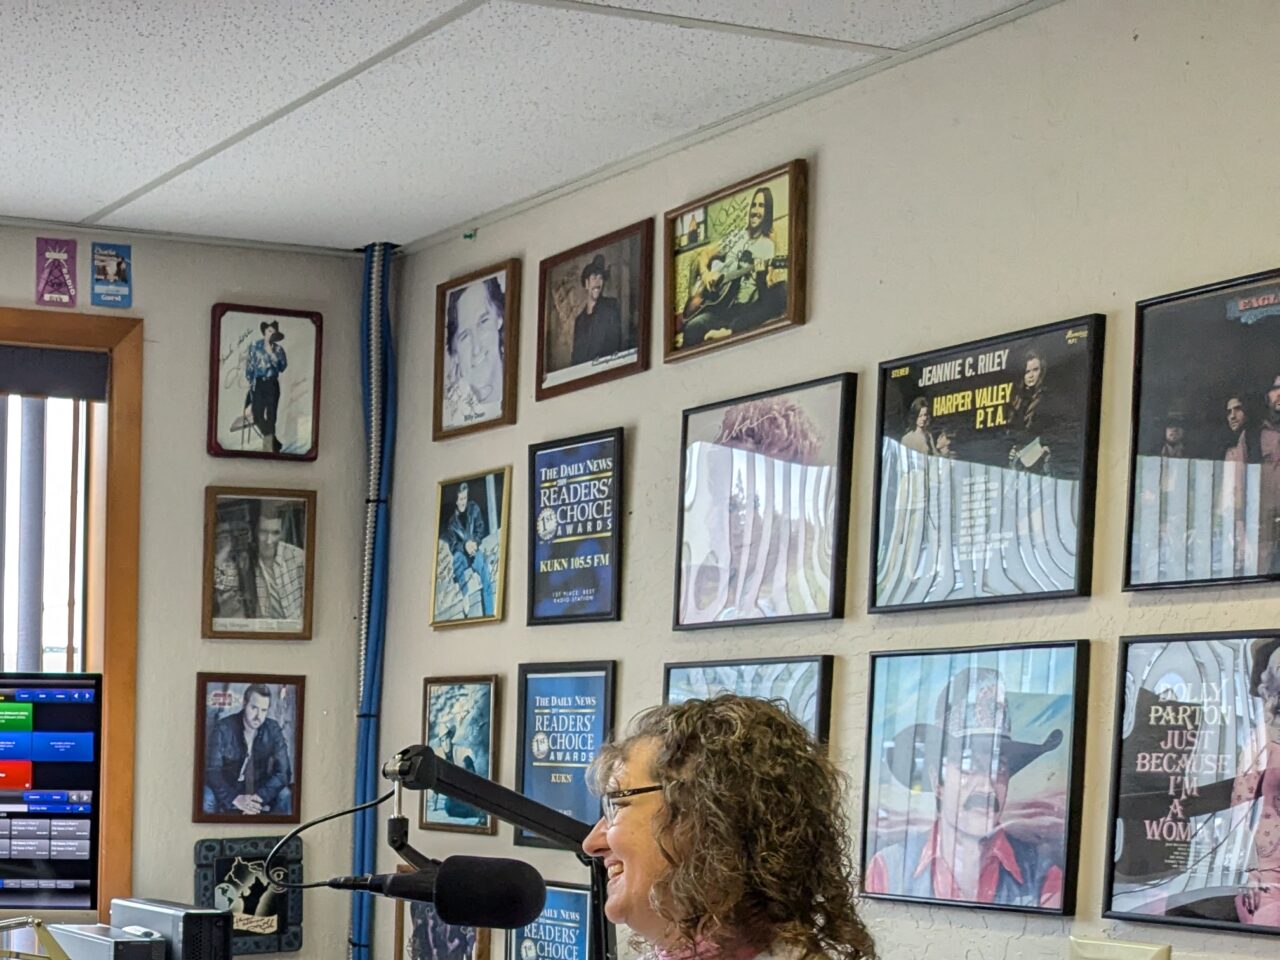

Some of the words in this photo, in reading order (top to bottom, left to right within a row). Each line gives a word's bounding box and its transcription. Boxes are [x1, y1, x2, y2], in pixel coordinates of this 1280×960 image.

[891, 367, 909, 378] STEREO
[918, 359, 962, 387] JEANNIE
[965, 357, 975, 376] C.
[933, 390, 971, 417] HARPER
[975, 382, 1013, 407] VALLEY
[540, 466, 558, 481] THE
[560, 462, 586, 478] DAILY
[586, 457, 613, 473] NEWS
[539, 478, 613, 508] READERS'
[556, 499, 612, 524] CHOICE
[556, 518, 612, 536] AWARDS
[539, 558, 568, 573] KUKN
[570, 555, 592, 570] 105.5
[594, 553, 609, 567] FM
[1158, 679, 1229, 702] DOLLY
[535, 696, 550, 707] THE
[551, 696, 572, 707] DAILY
[574, 696, 596, 706] NEWS
[535, 715, 595, 731] READERS'
[1149, 705, 1233, 731] PARTON
[548, 733, 595, 750] CHOICE
[1160, 730, 1216, 750] JUST
[549, 751, 594, 762] AWARDS
[1136, 753, 1230, 774] BECAUSE
[550, 773, 572, 783] KUKN
[1169, 776, 1200, 800] I'M
[1165, 799, 1184, 822] A
[540, 908, 558, 918] AILY
[560, 909, 580, 920] NEWS
[523, 924, 580, 944] READERS'
